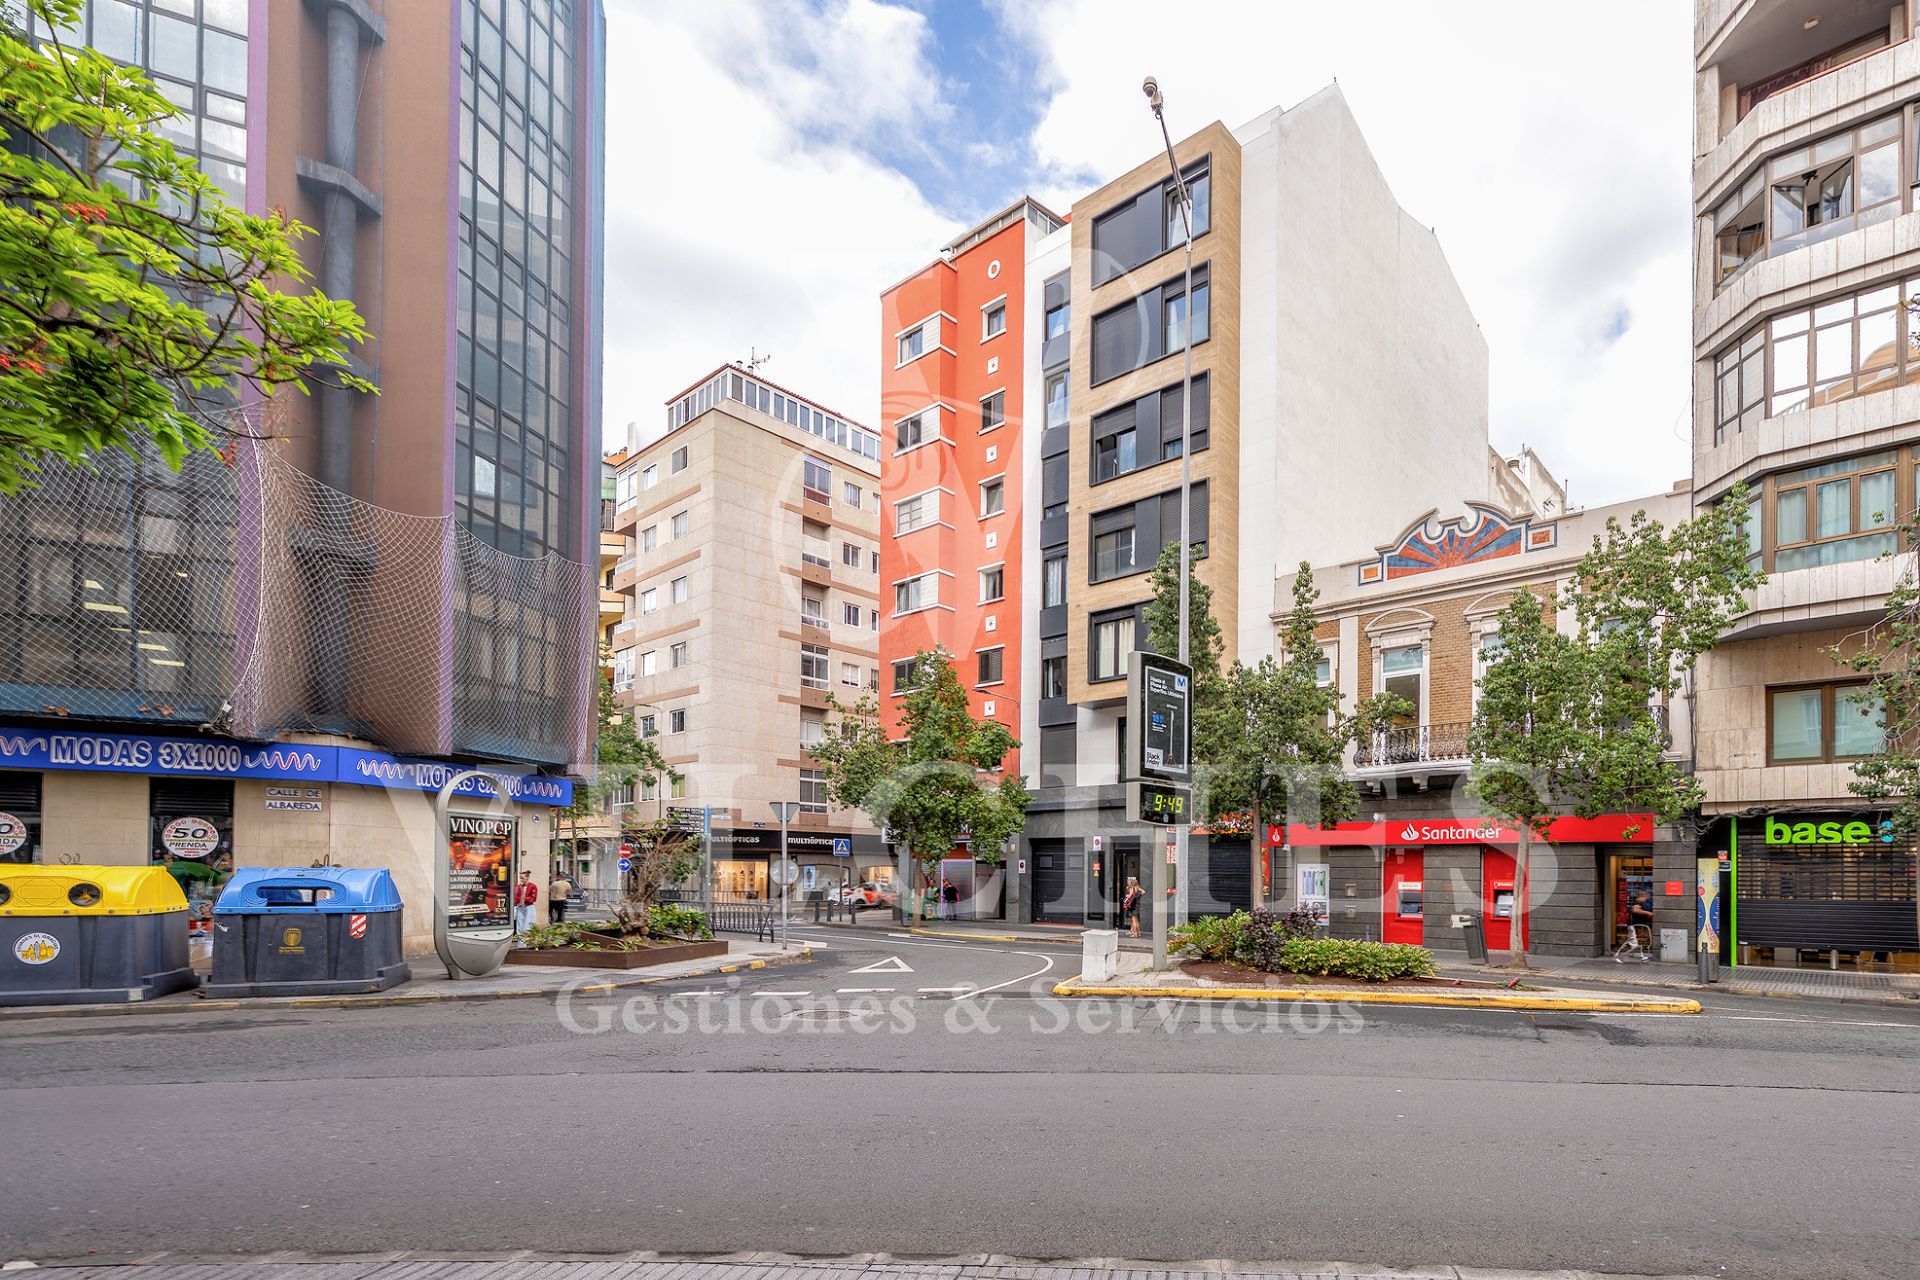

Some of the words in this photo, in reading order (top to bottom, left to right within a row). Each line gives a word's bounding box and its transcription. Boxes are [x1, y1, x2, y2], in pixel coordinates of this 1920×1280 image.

[51, 736, 152, 768] MODAS
[157, 741, 242, 772] 3X1000
[1147, 752, 1160, 760] Black
[268, 788, 300, 797] CALLE
[305, 789, 321, 797] DE
[267, 801, 321, 810] ALBAREDA
[1154, 794, 1184, 813] 9:49
[450, 818, 512, 835] VINOPOP
[1422, 826, 1502, 840] Santander
[496, 898, 506, 908] 17
